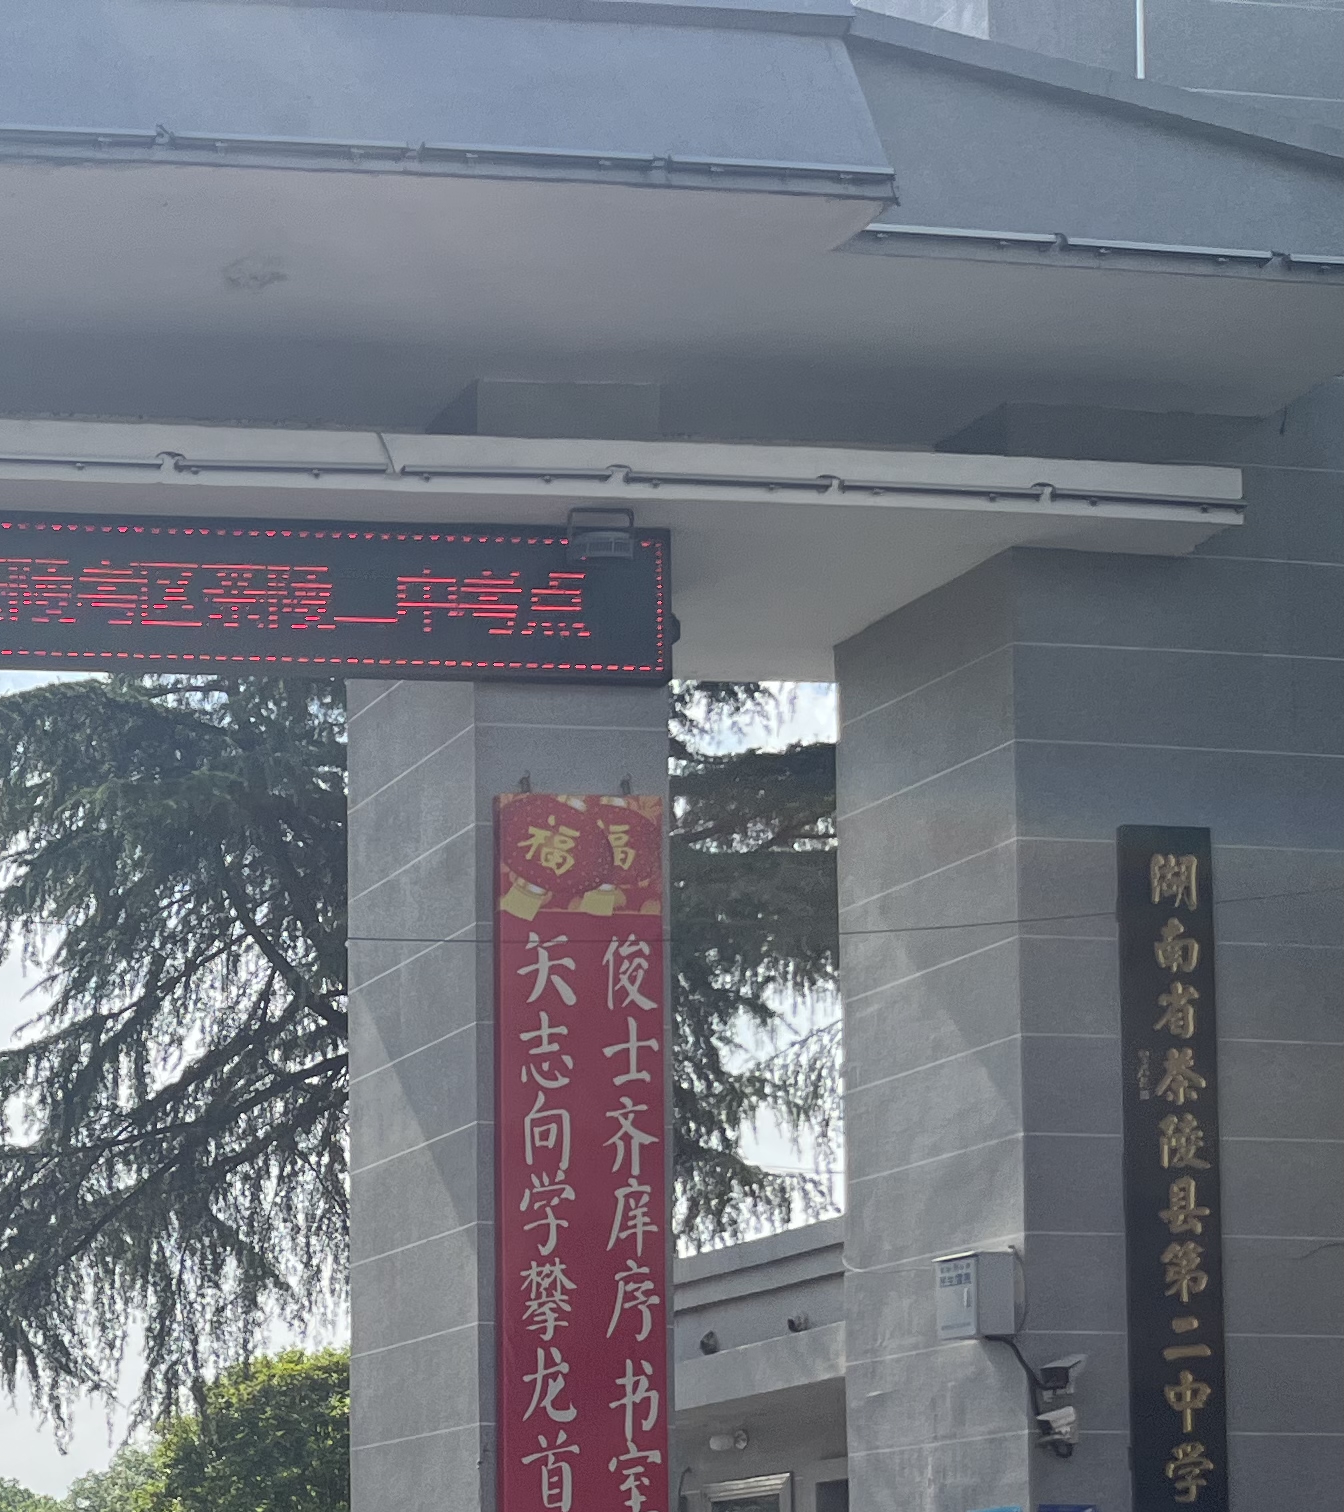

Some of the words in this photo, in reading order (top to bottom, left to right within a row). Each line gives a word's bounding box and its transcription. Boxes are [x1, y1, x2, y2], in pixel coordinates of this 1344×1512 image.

[517, 815, 580, 876] 福
[516, 931, 580, 1512] 矢志向学攀龙首
[1150, 854, 1214, 1503] 湖南省茶陵县第二中学
